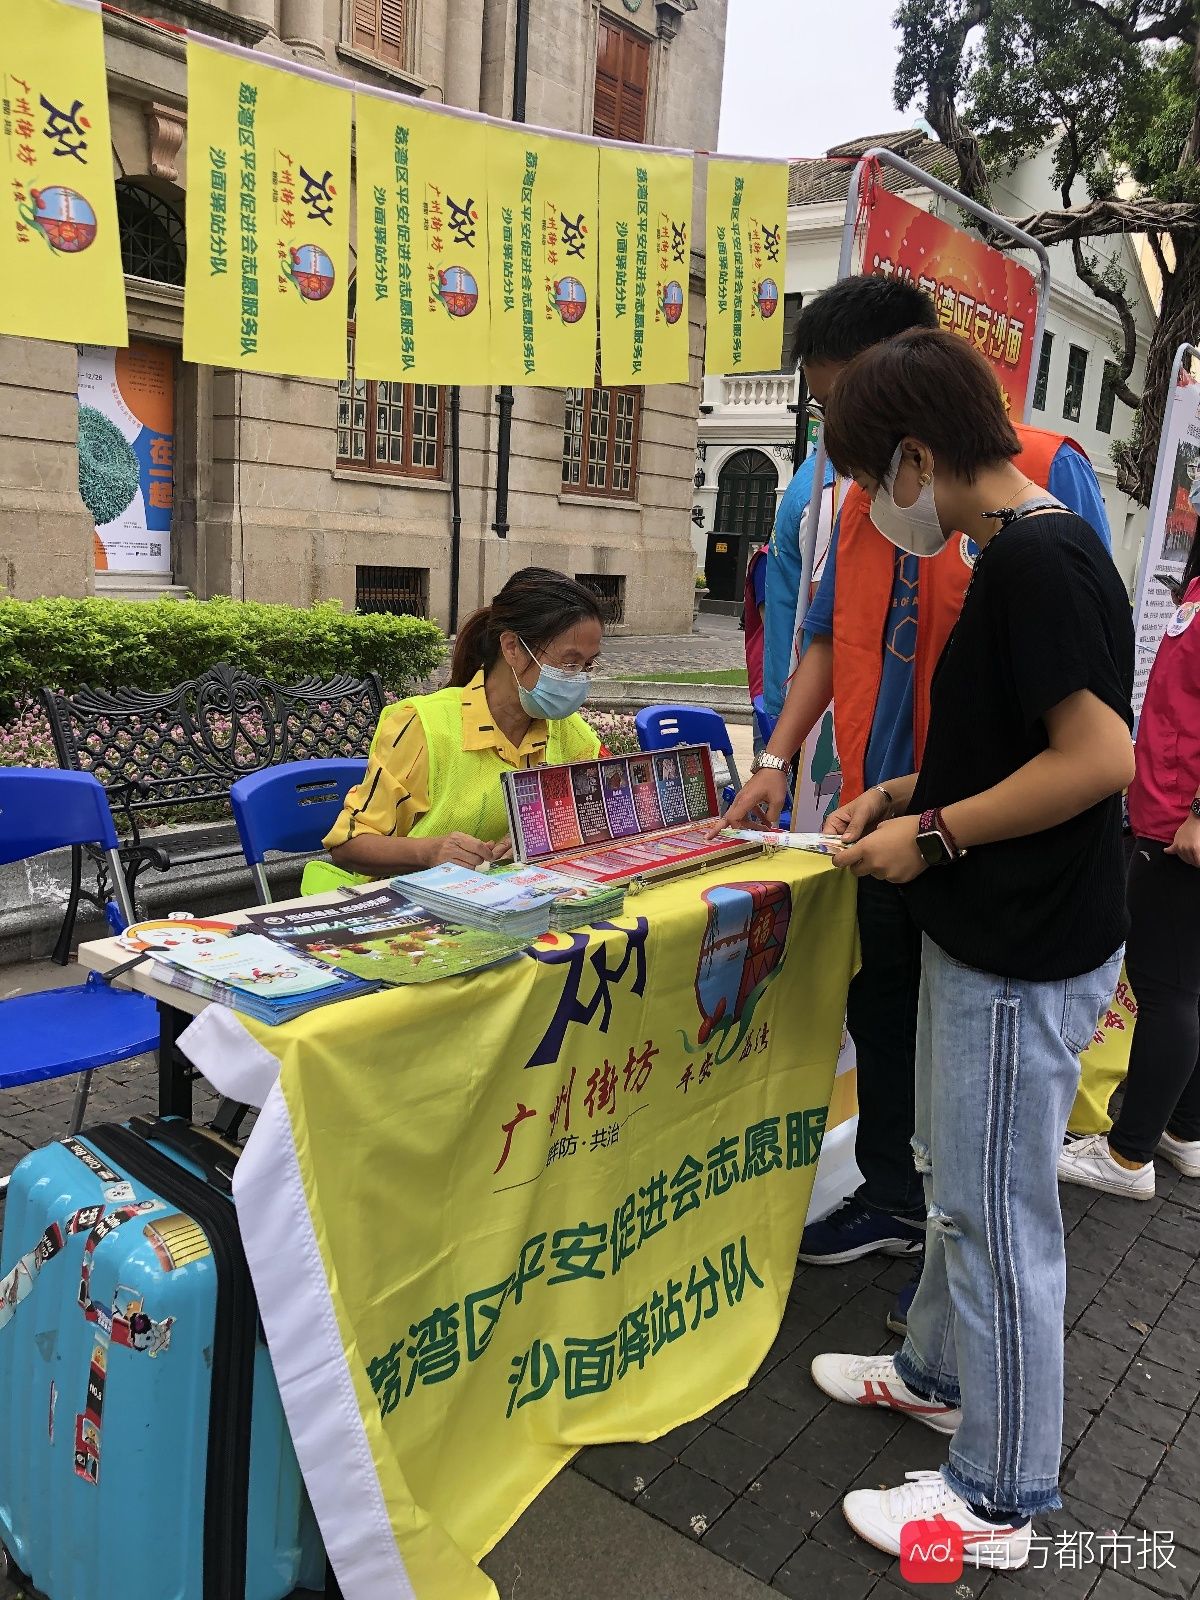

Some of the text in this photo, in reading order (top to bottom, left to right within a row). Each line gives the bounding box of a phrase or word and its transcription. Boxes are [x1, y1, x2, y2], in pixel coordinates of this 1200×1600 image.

[209, 147, 228, 277] 沙面驿站分队
[238, 82, 260, 357] 荔湾区平安促进会志愿服务队
[373, 185, 389, 301] 沙面驿站分队
[394, 125, 416, 371] 荔湾区平安促进会志愿服务队
[502, 207, 514, 312] 沙面驿站分队
[521, 151, 538, 375] 荔湾区平安促进会志愿服务队
[616, 222, 628, 318] 沙面驿站分队
[632, 168, 649, 375] 荔湾区平安促进会志愿服务队
[717, 226, 729, 314] 沙面驿站分队
[731, 177, 744, 366] 荔湾区平安促进会志愿服务队
[493, 1040, 659, 1174] 广州街坊
[506, 1235, 764, 1418] 沙面驿站分队
